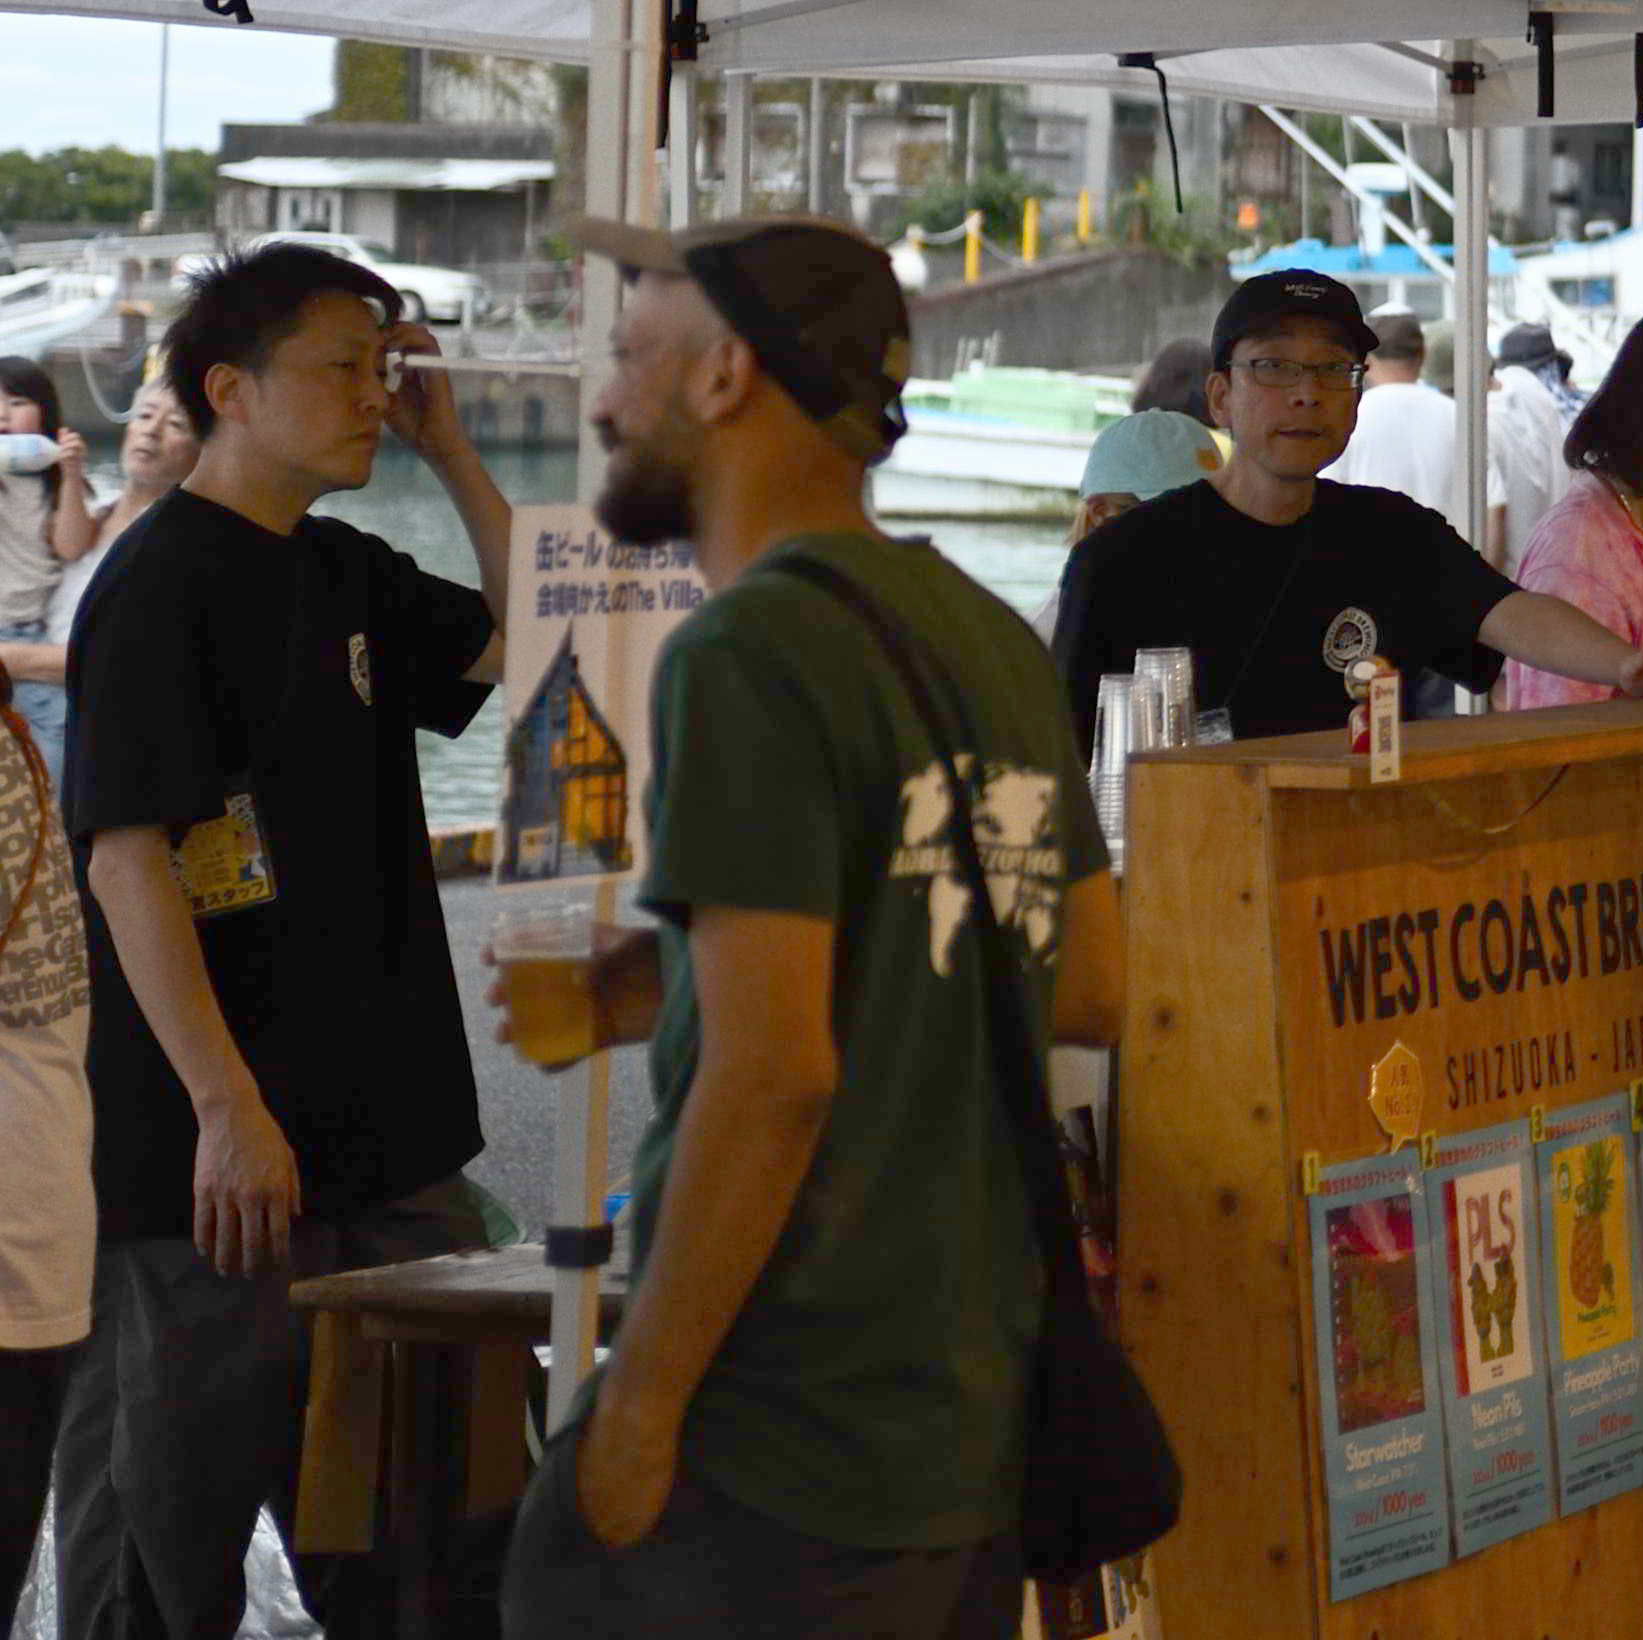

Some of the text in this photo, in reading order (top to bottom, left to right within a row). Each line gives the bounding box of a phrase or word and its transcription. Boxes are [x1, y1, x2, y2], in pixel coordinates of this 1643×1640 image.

[1320, 909, 1440, 1028] WEST
[1450, 882, 1588, 1003] COAST
[1447, 1029, 1577, 1112] SHIZUOKA
[1424, 1135, 1434, 1168] 2
[1344, 1426, 1425, 1473] Starwatcher
